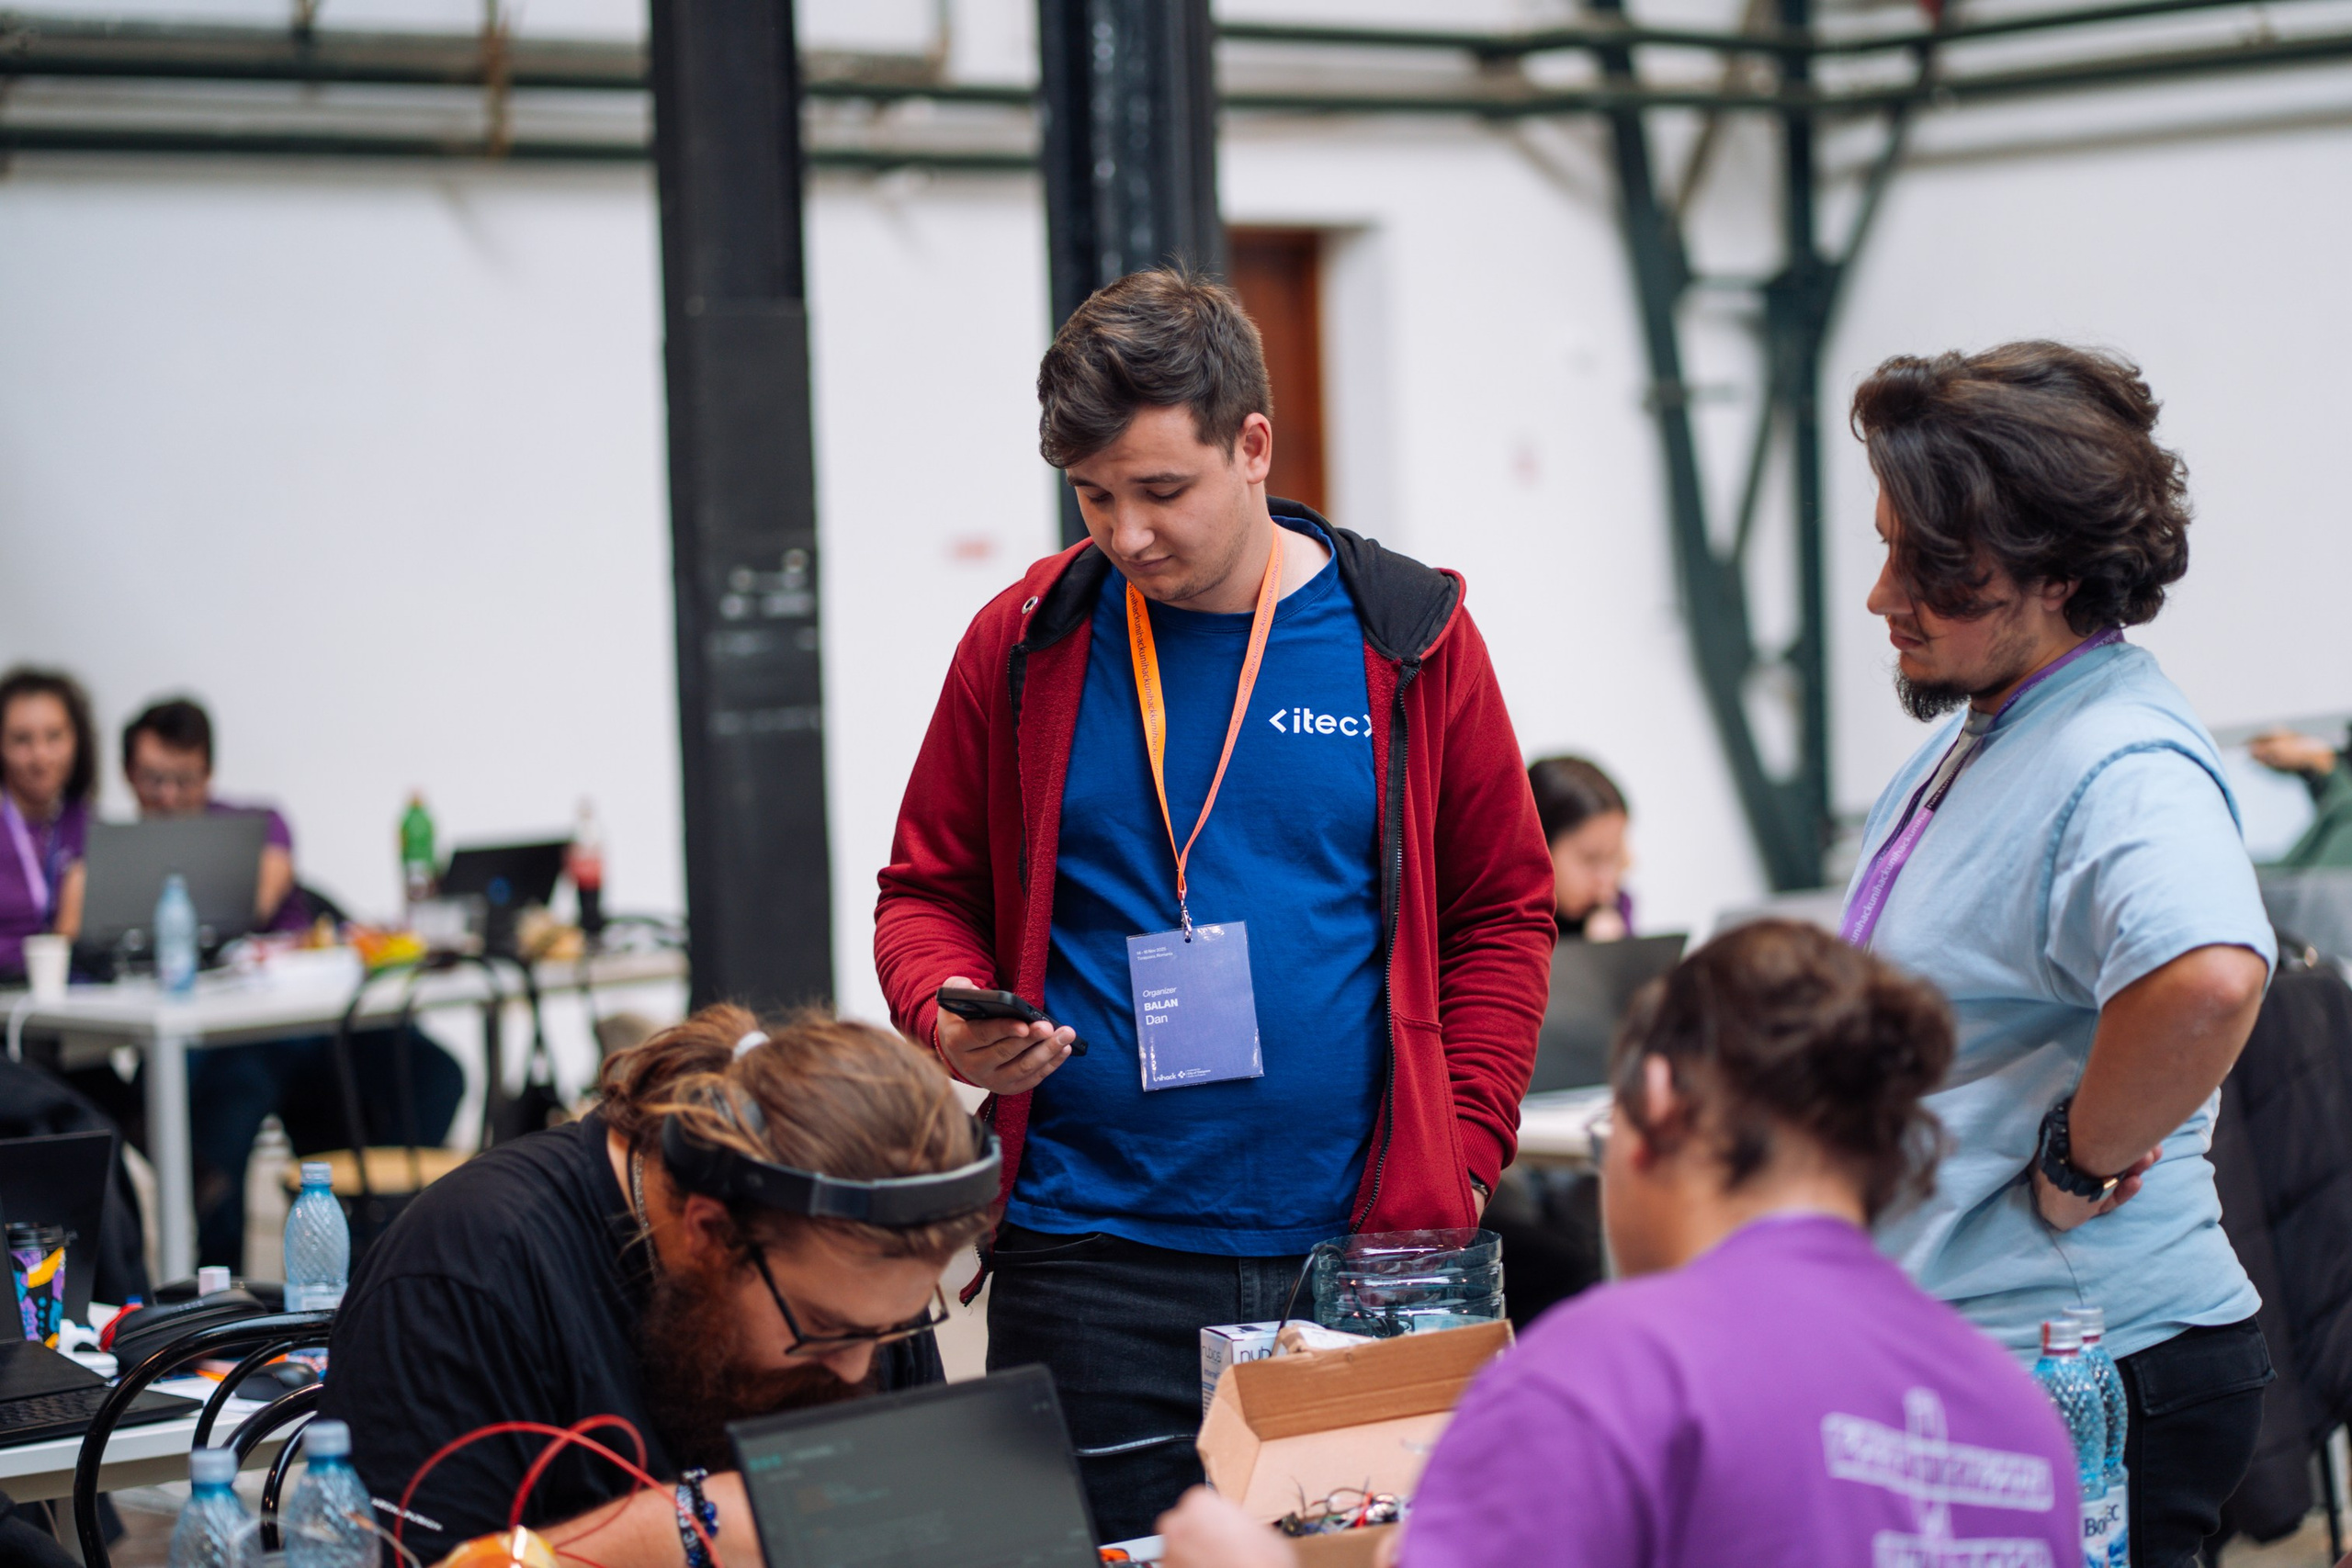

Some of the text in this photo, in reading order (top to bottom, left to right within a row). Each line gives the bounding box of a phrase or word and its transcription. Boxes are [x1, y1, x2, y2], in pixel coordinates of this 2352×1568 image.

[1142, 987, 1177, 998] Organizer
[1144, 998, 1178, 1011] BALAN
[1146, 1014, 1168, 1026] Dan
